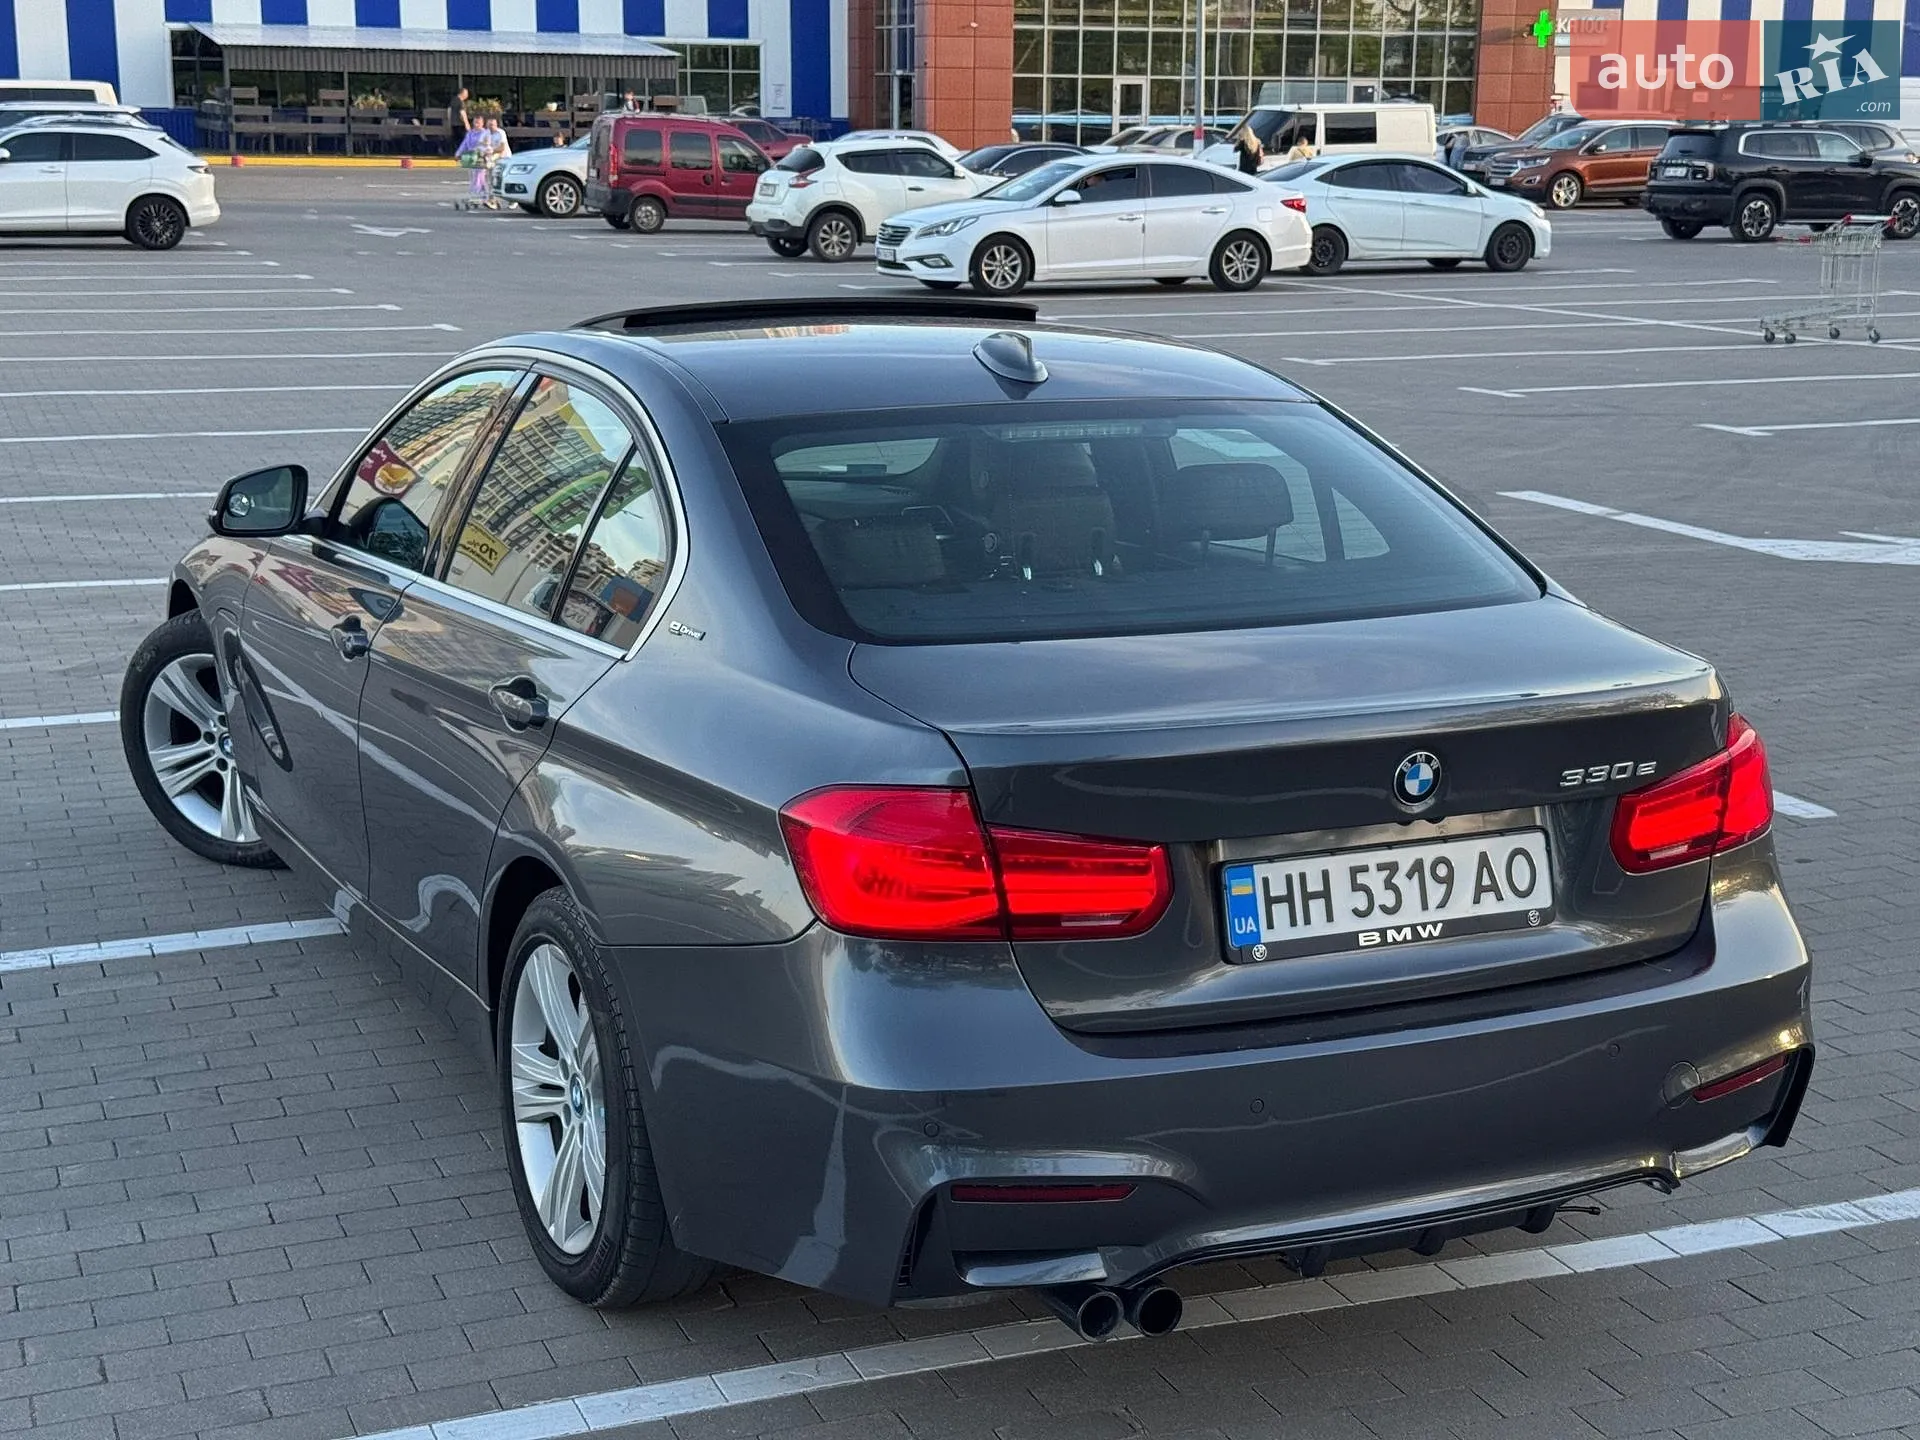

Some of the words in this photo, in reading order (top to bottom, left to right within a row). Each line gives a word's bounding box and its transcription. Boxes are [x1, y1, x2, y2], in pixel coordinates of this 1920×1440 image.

[1401, 754, 1440, 773] BMW
[1559, 761, 1658, 788] 330e
[1261, 869, 1334, 931] HH
[1349, 855, 1456, 919] 5319
[1472, 847, 1538, 906] AO
[1234, 917, 1257, 934] UA
[1357, 922, 1444, 947] BMW
